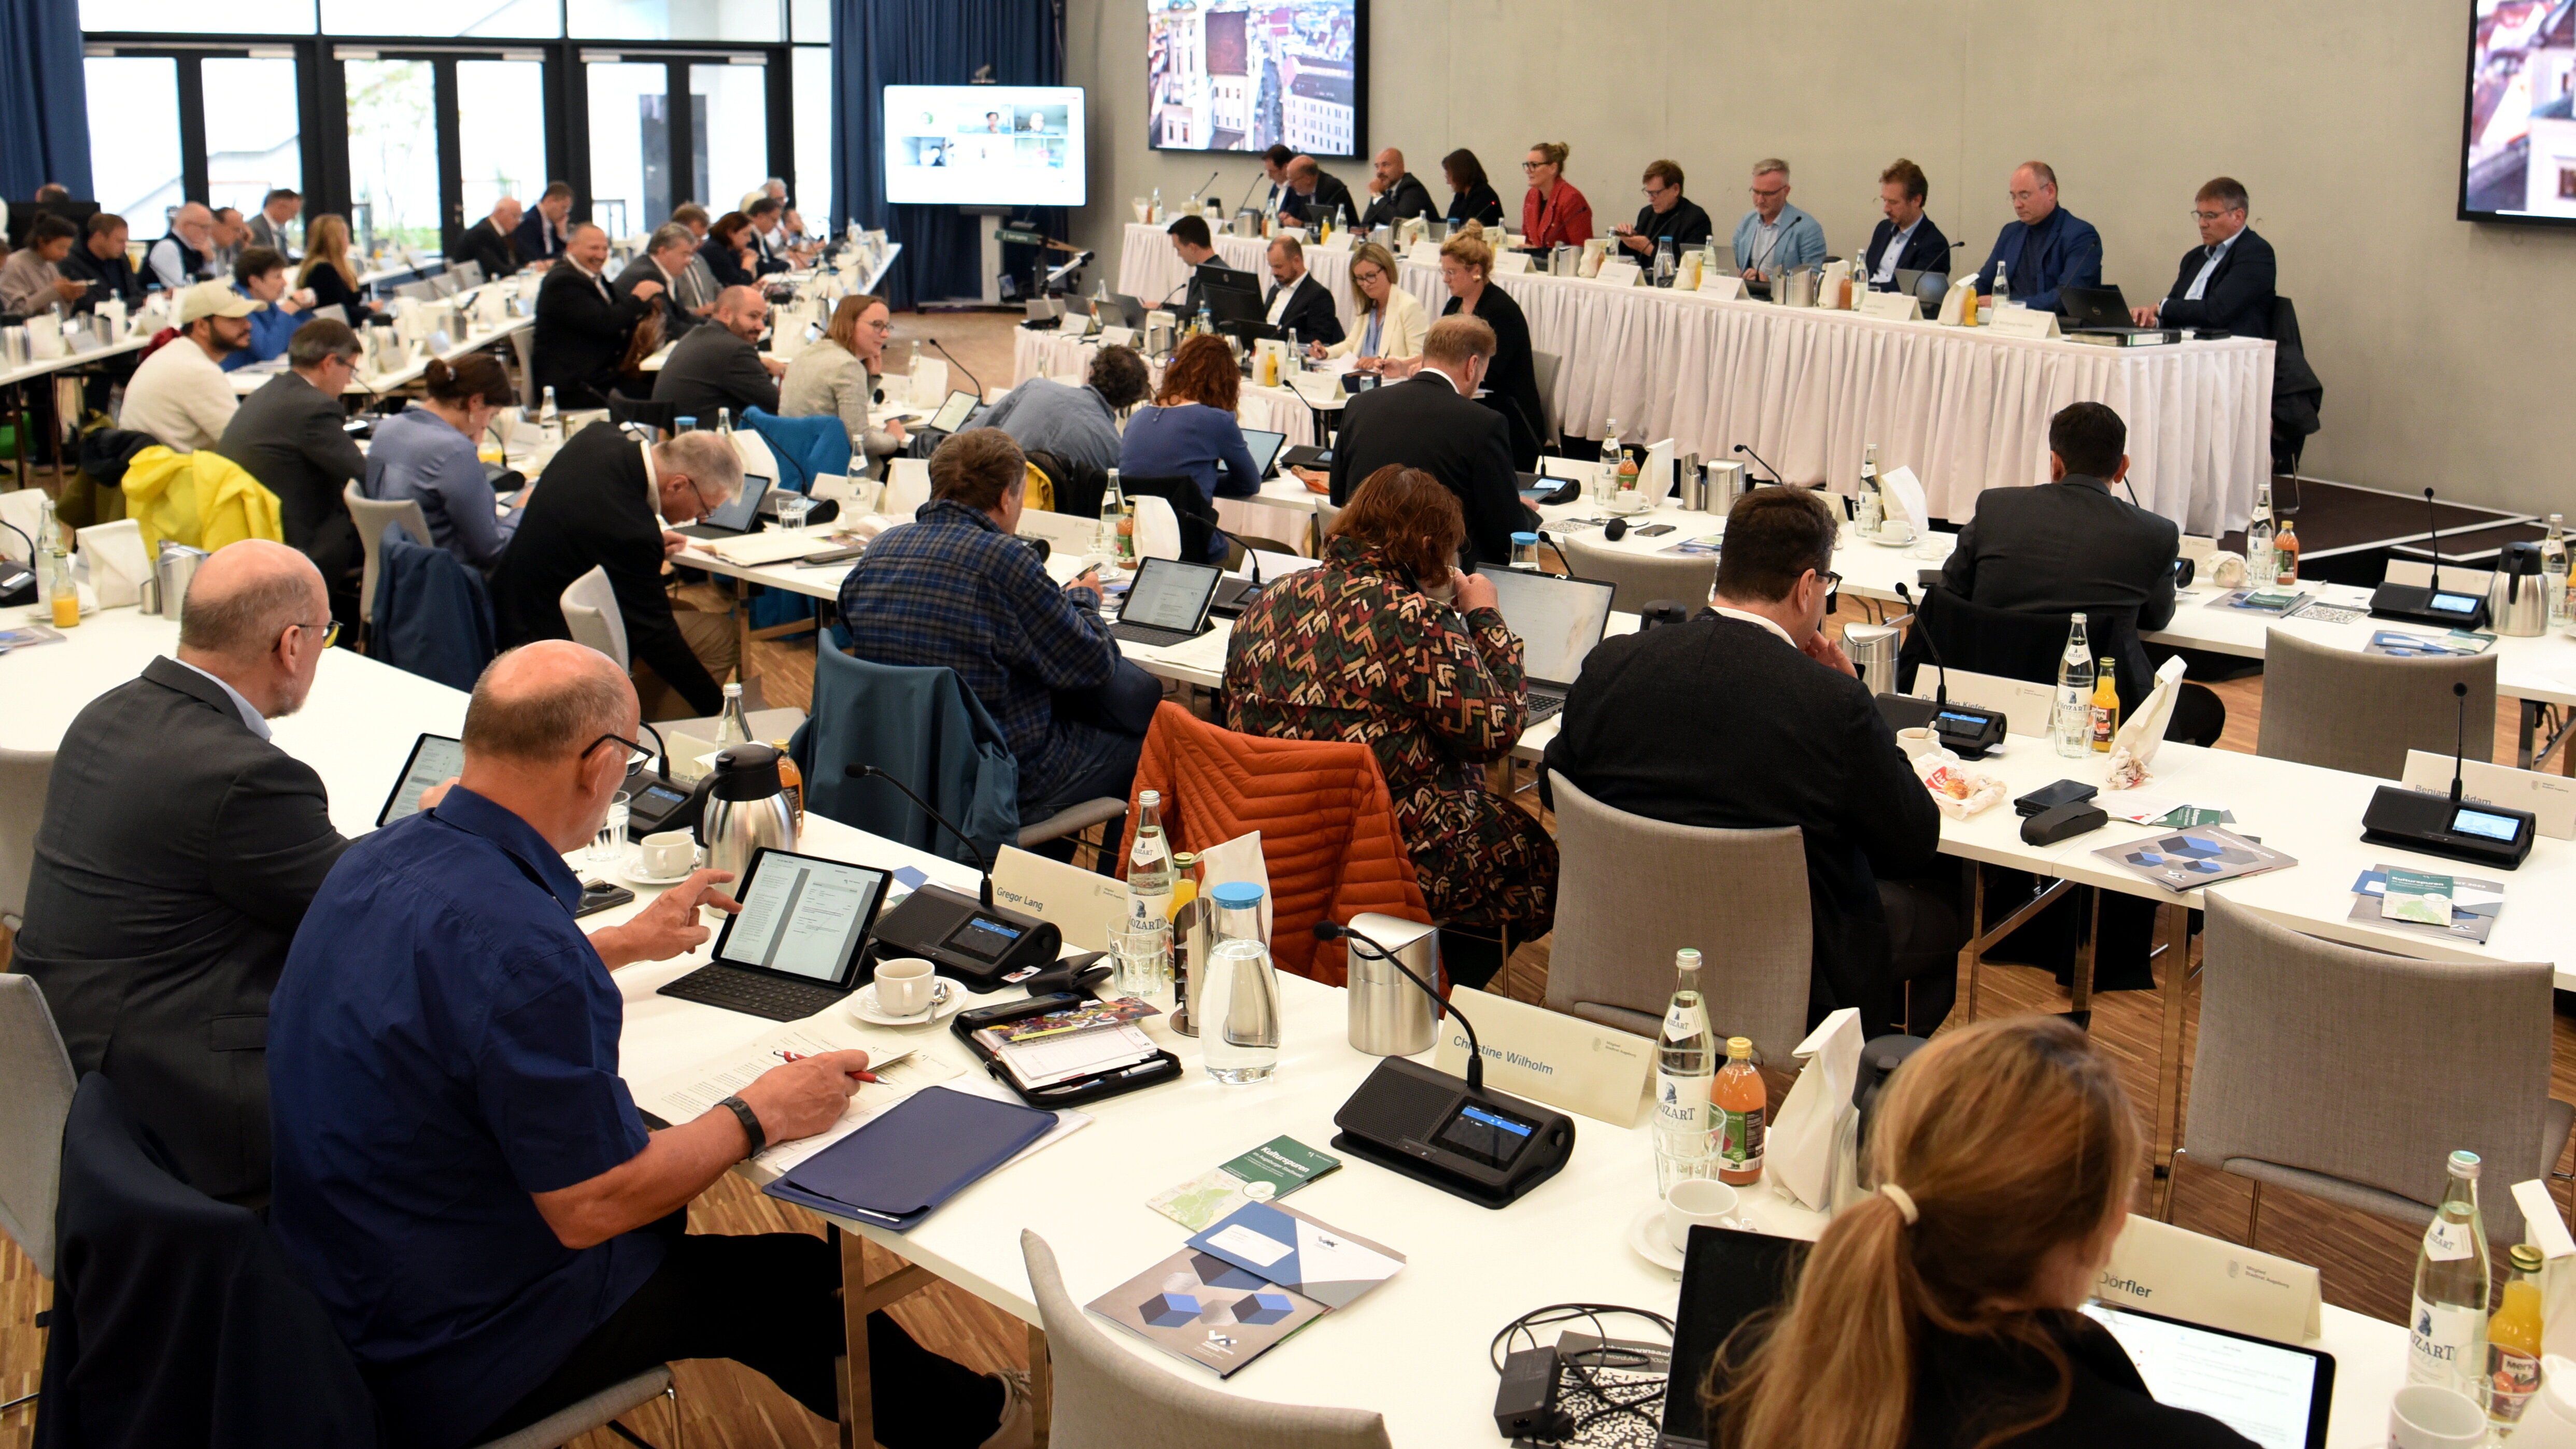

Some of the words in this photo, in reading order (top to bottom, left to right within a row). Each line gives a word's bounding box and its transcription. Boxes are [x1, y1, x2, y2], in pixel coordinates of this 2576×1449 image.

[2463, 794, 2492, 805] Adam
[1134, 847, 1153, 856] MOZART
[2391, 876, 2444, 887] Kulturspuren
[997, 887, 1022, 902] Gregor
[1024, 896, 1043, 912] Lang
[1453, 1035, 1502, 1059] Chrstine
[1507, 1051, 1553, 1075] Wilholm
[1260, 1146, 1310, 1173] Kulturspuren
